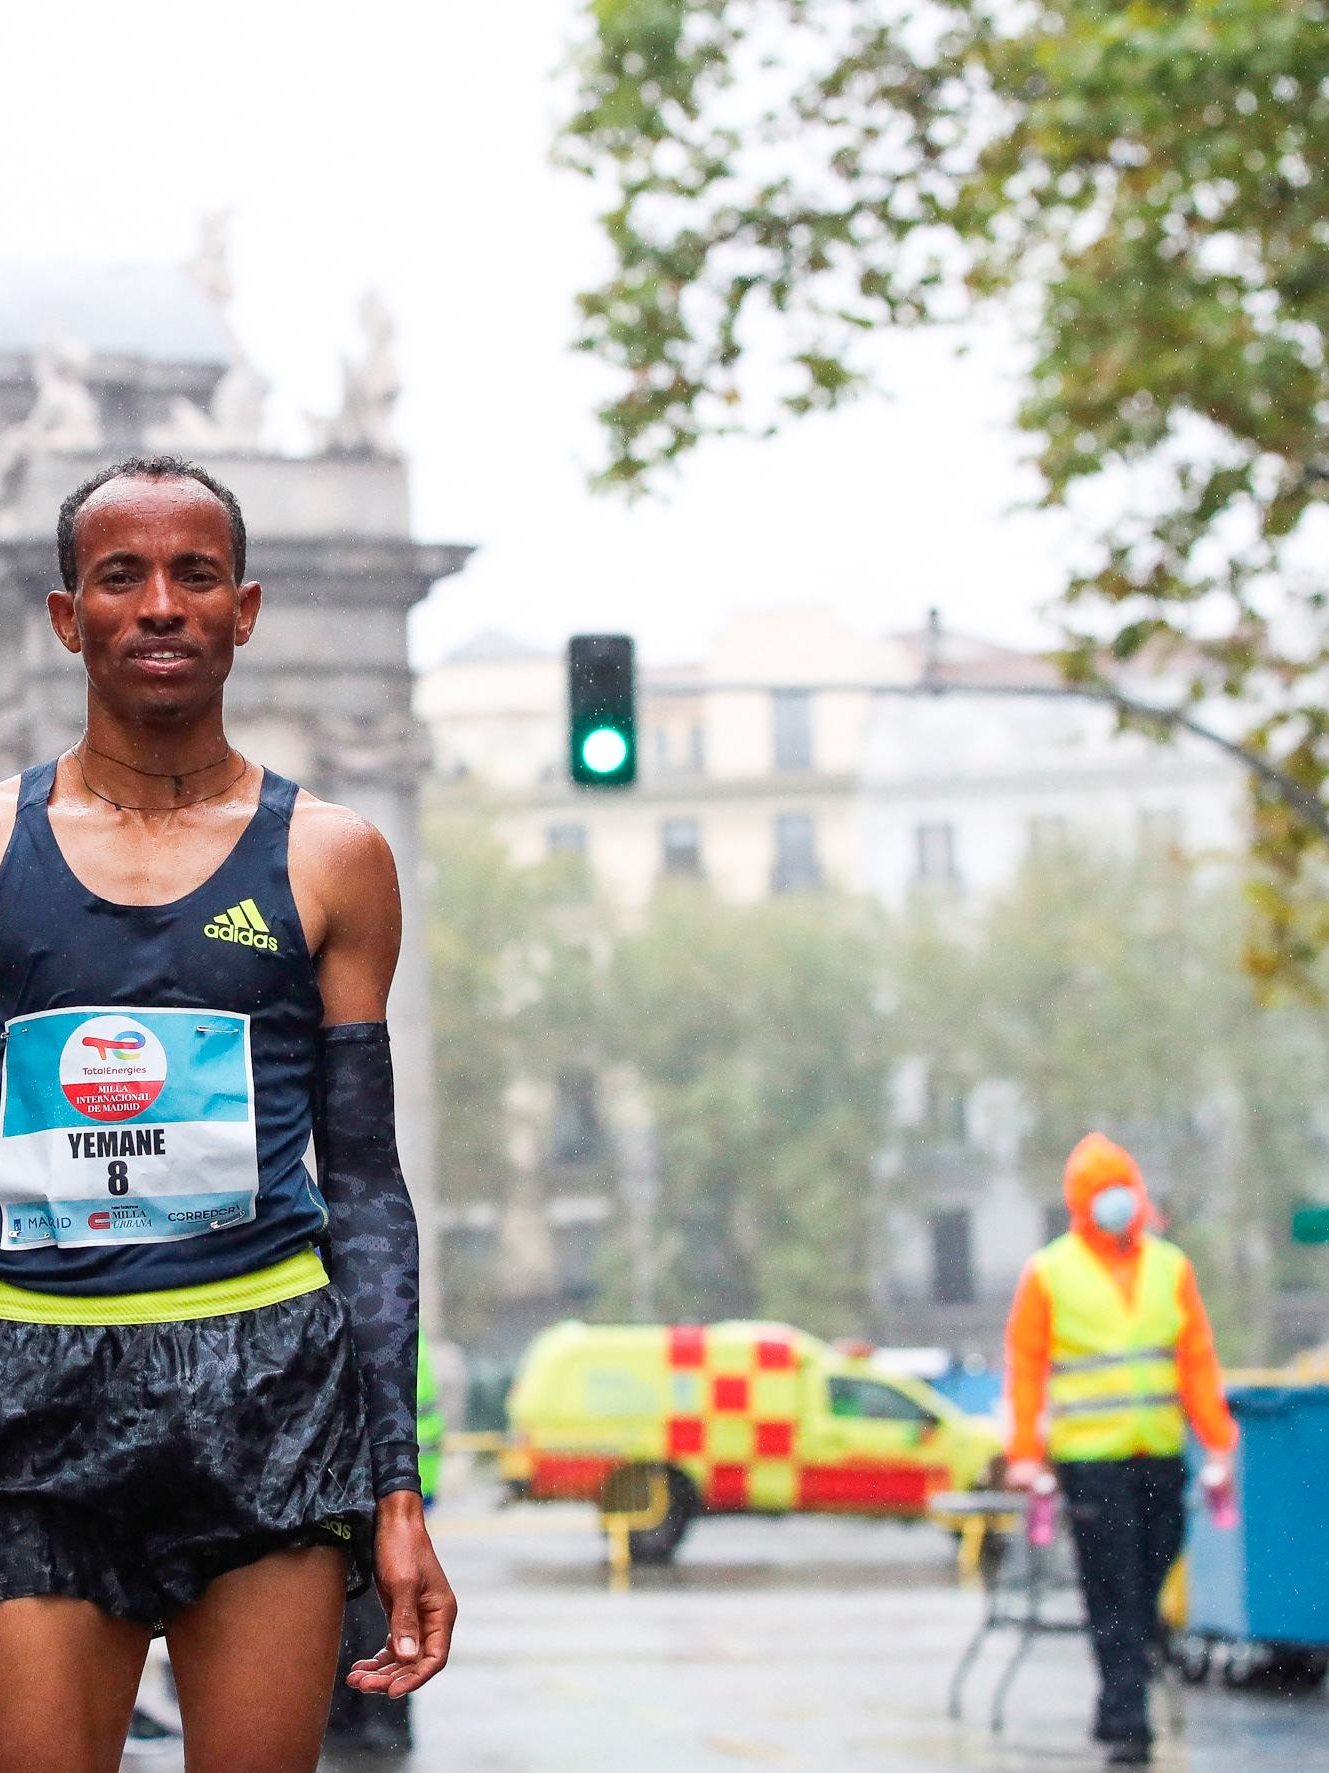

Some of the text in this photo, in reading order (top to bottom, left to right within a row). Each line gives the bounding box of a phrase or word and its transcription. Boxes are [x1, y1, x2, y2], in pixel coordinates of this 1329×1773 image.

[203, 923, 278, 952] adidas
[82, 1066, 147, 1076] TotalEnergies
[98, 1084, 129, 1093] MILLA
[87, 1102, 141, 1113] DE MADRID
[67, 1129, 166, 1159] YEMANE
[107, 1160, 129, 1196] 8
[112, 1209, 148, 1220] MILLA
[28, 1216, 72, 1229] MARID
[113, 1217, 153, 1230] URBANA
